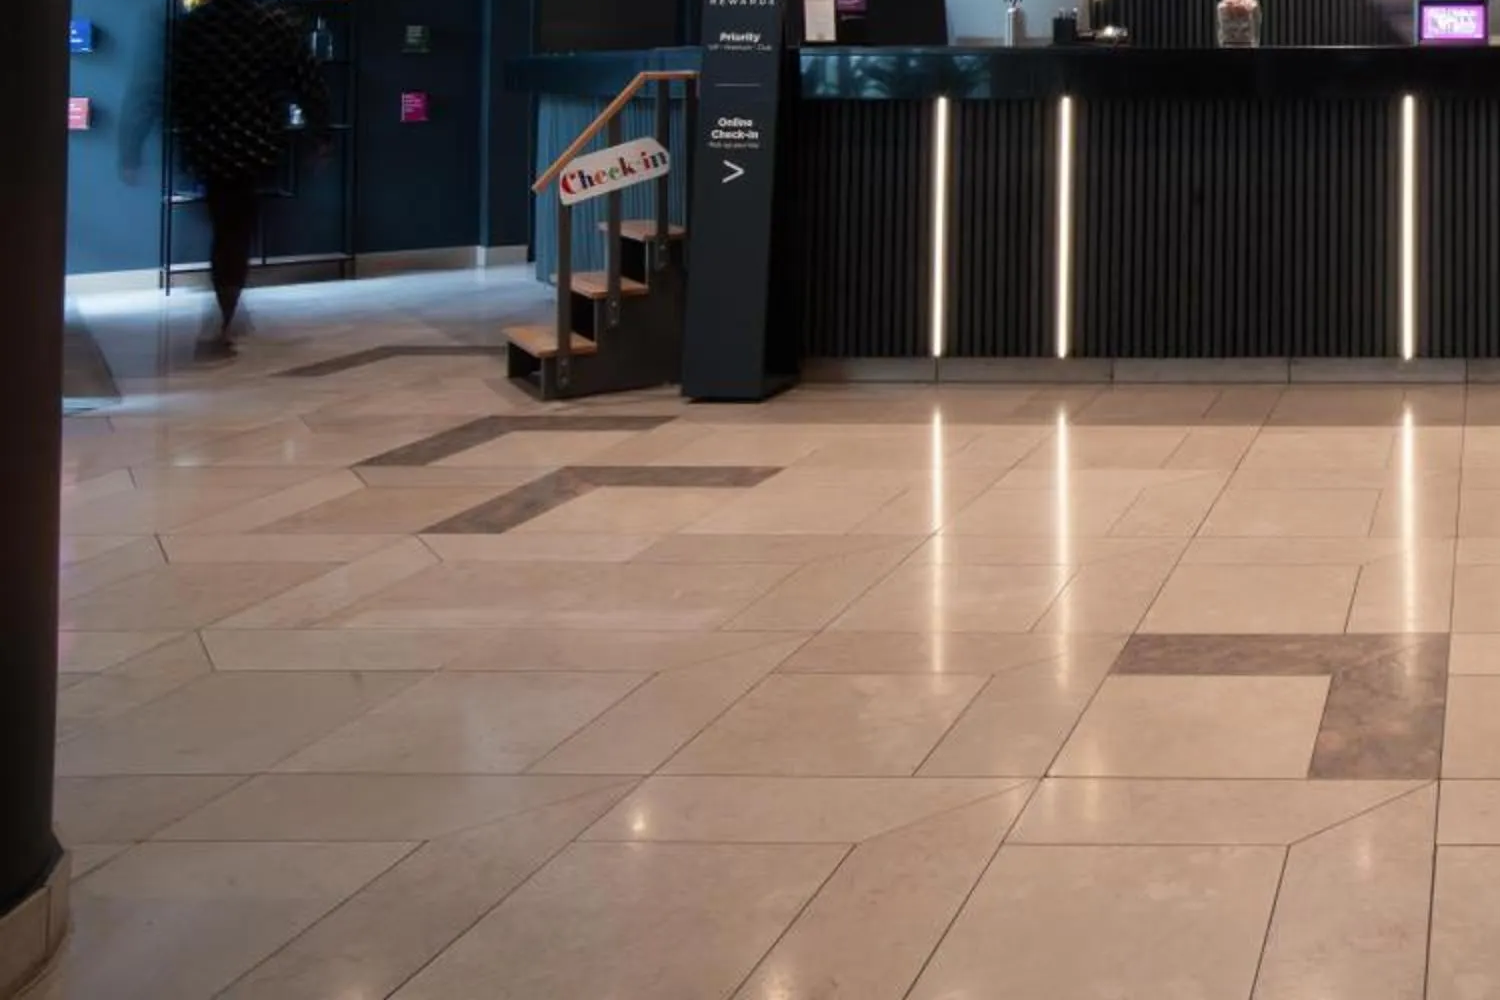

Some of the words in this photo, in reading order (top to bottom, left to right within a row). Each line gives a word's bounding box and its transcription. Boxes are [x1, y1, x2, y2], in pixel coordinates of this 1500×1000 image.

[719, 31, 762, 44] Priority
[717, 116, 754, 127] Online
[710, 128, 760, 140] Check-in
